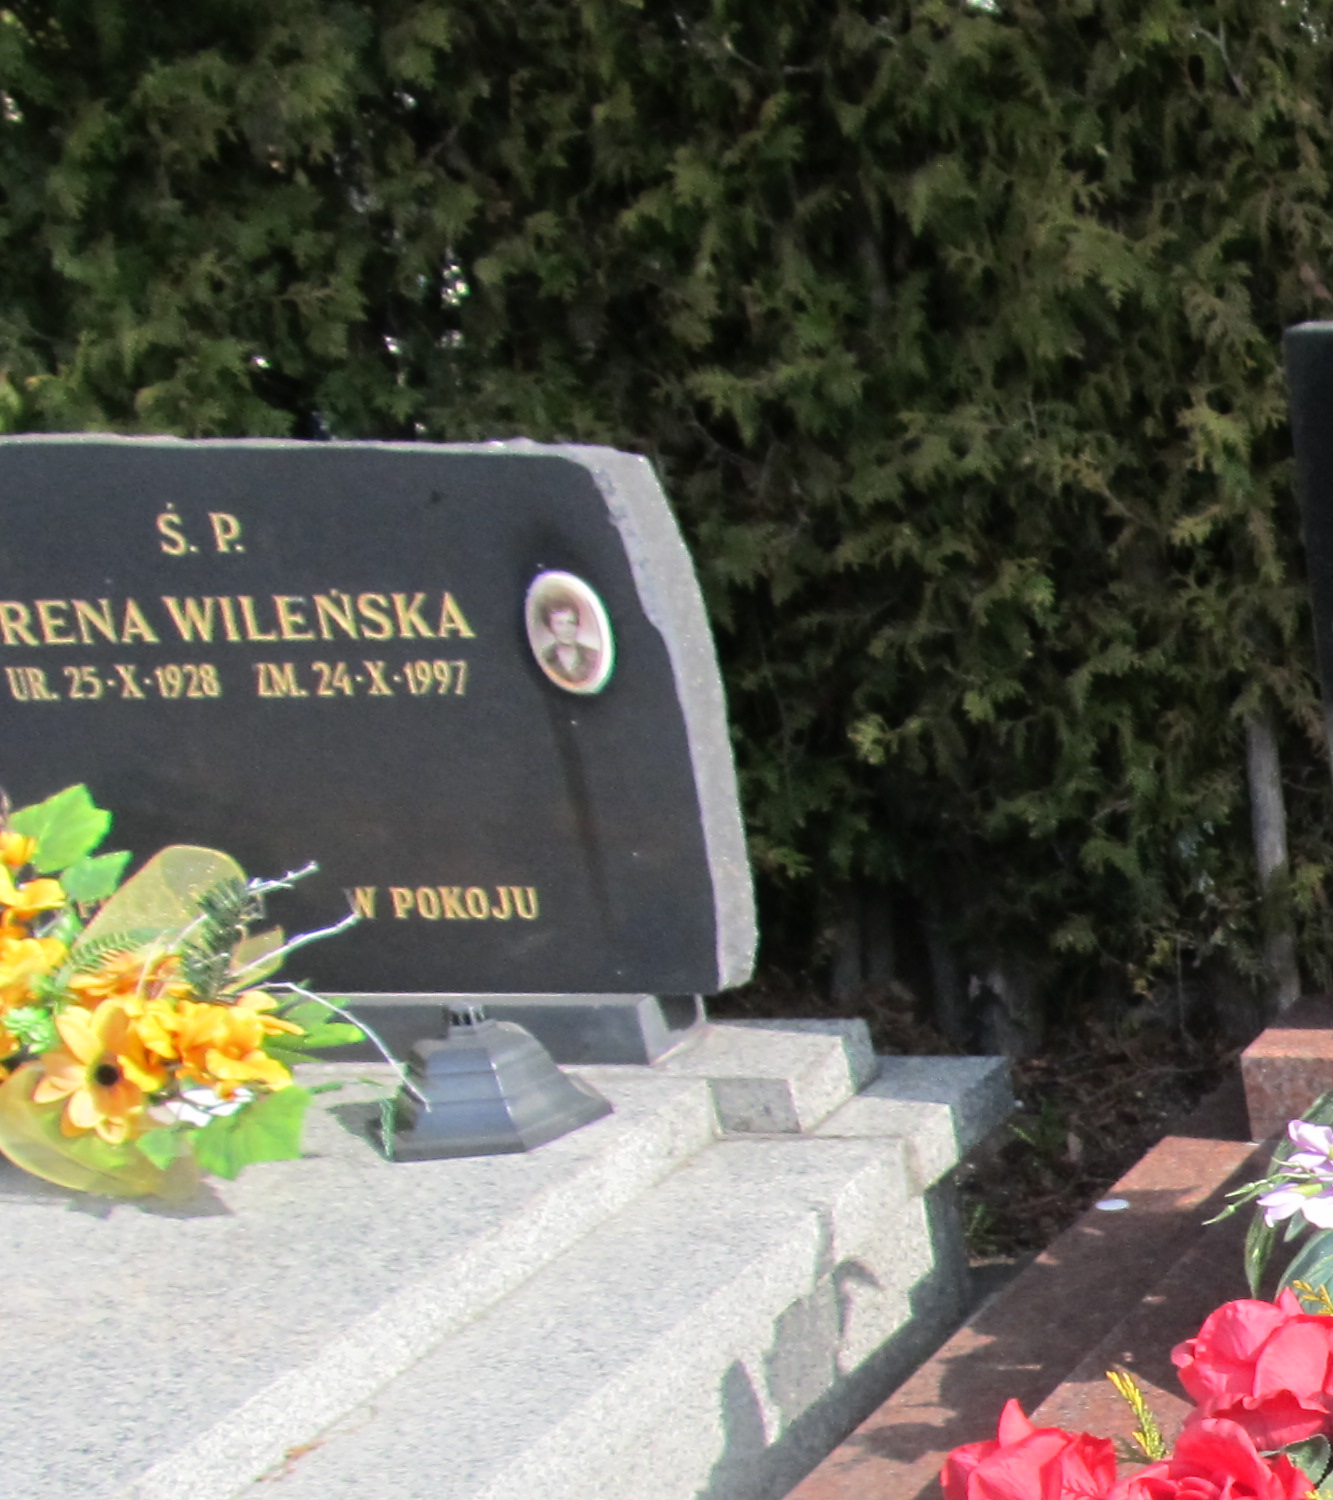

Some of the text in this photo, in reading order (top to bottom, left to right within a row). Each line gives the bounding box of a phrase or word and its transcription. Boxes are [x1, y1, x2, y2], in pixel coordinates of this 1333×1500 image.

[160, 588, 477, 644] WILEŃSKA
[5, 665, 60, 701] UR.
[253, 660, 310, 698] ZM.
[388, 885, 540, 921] POKOJU
